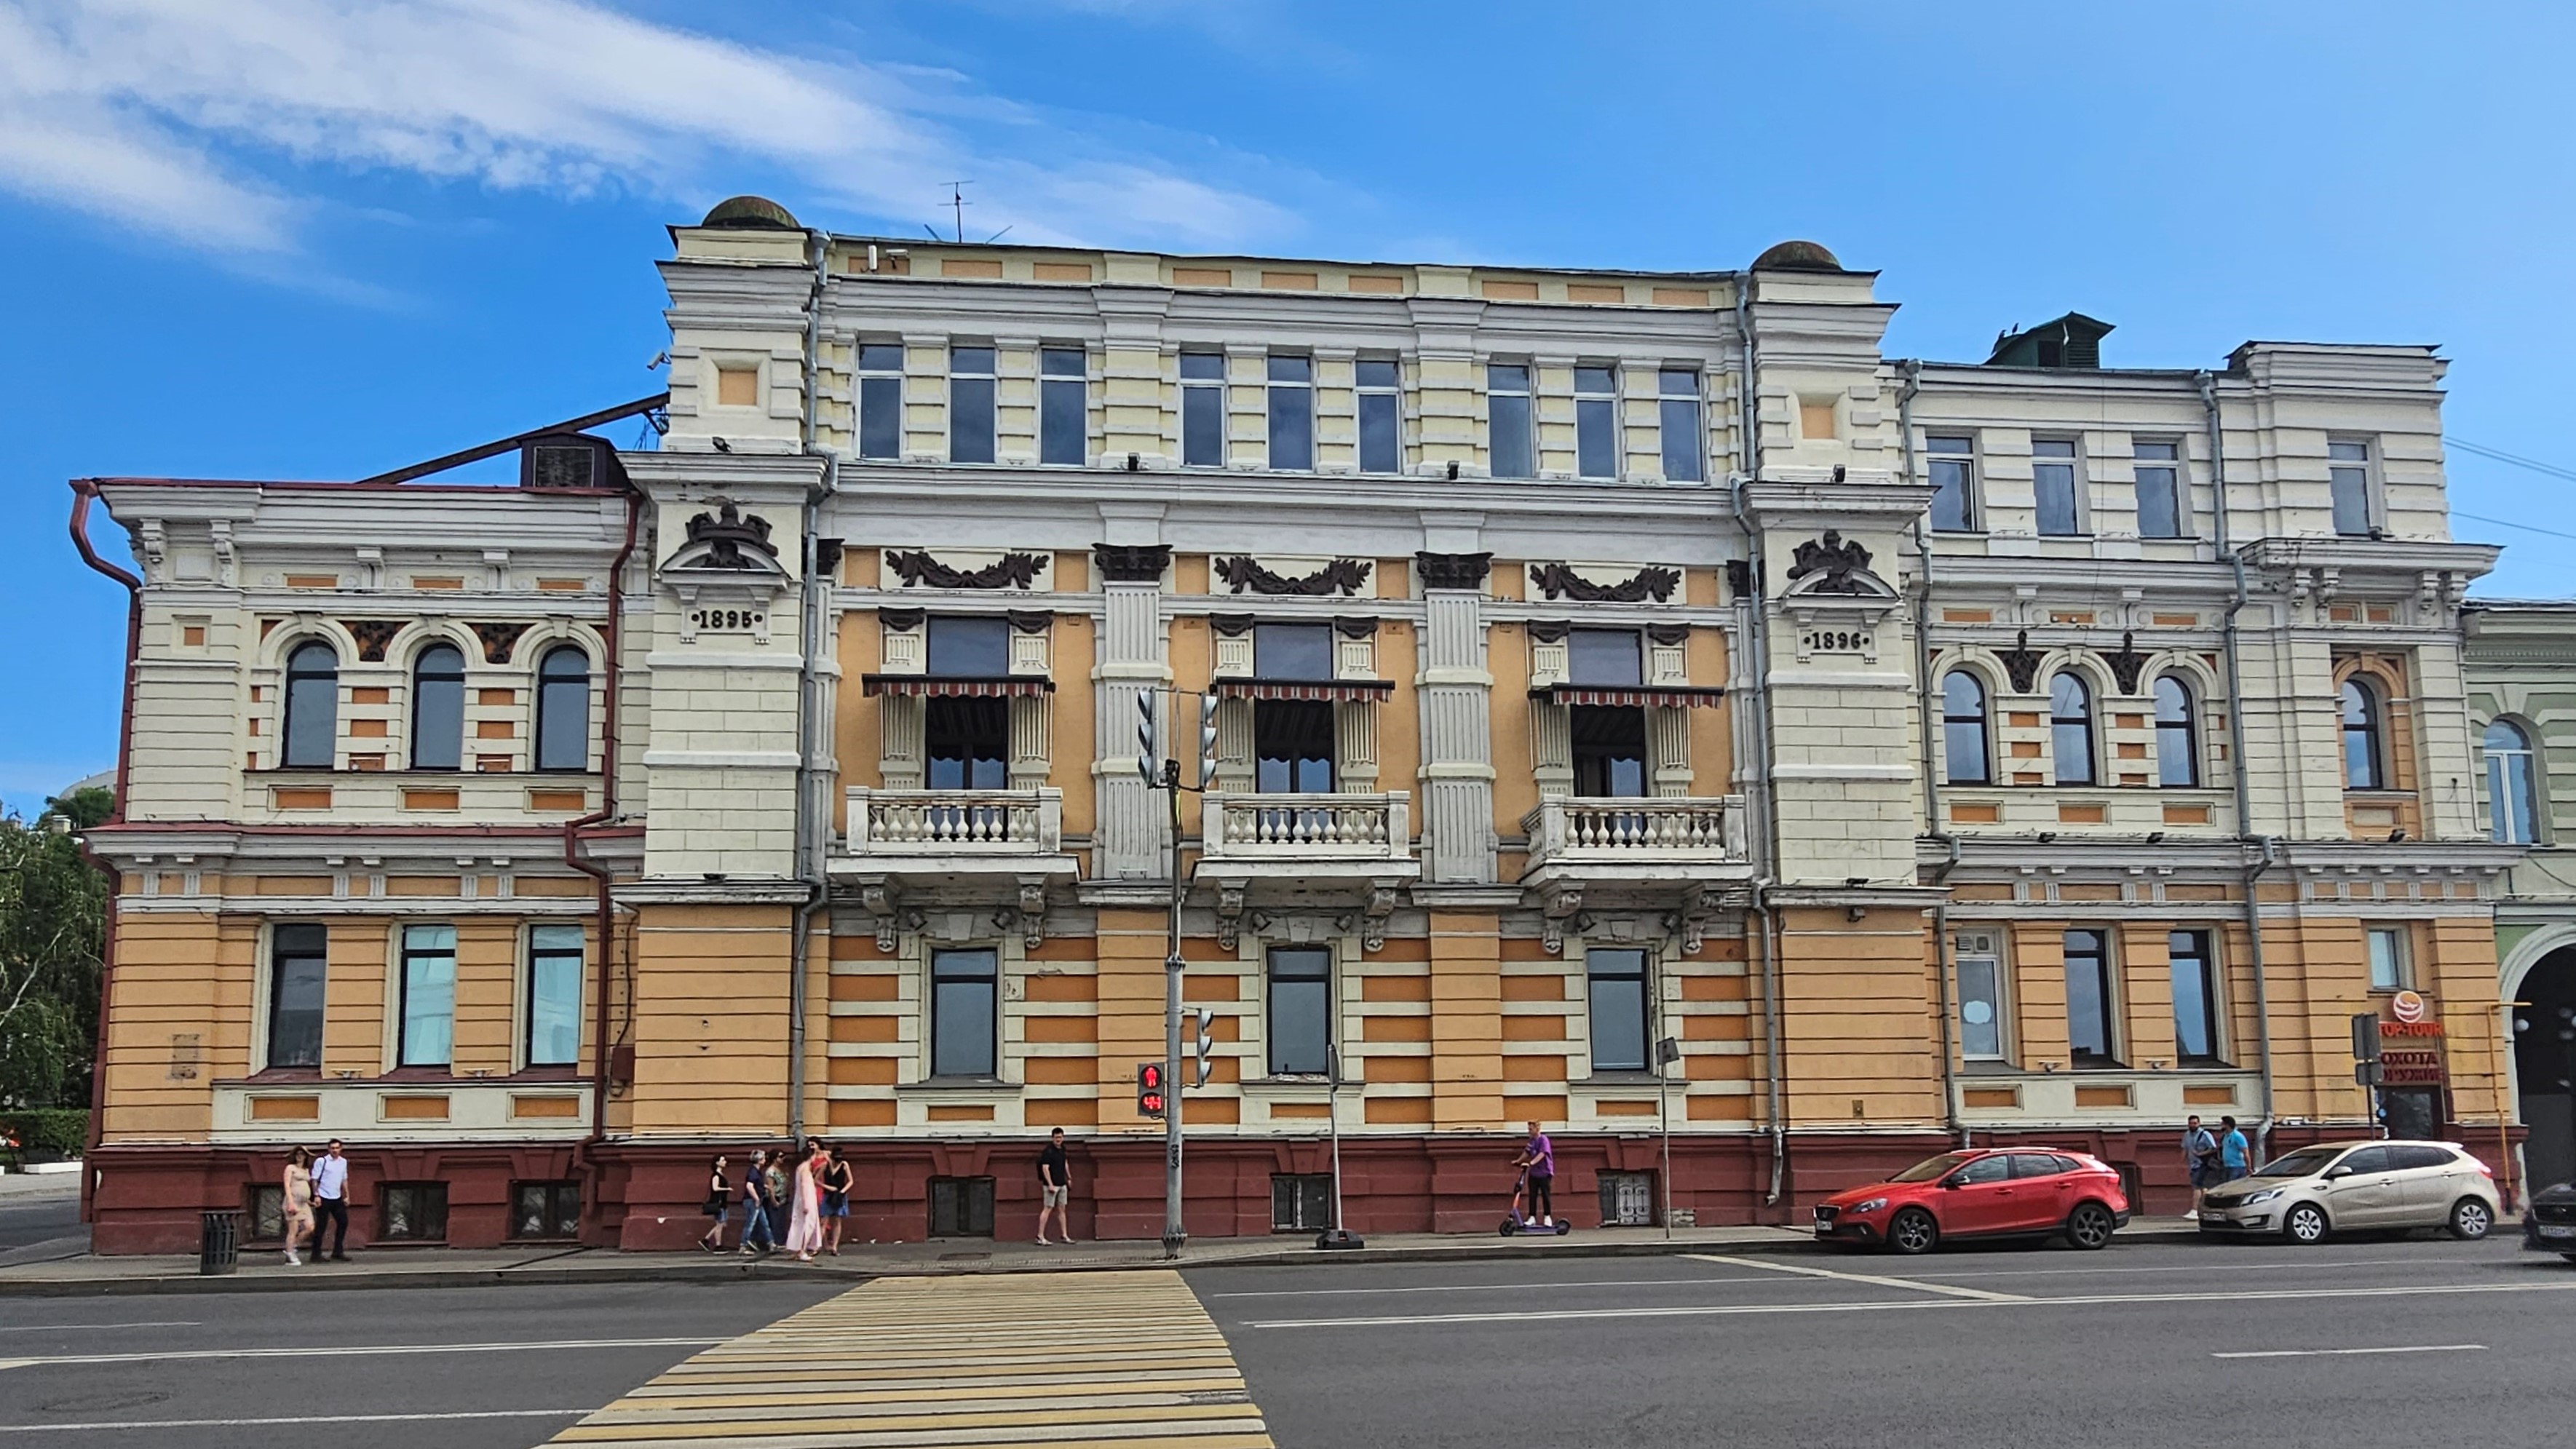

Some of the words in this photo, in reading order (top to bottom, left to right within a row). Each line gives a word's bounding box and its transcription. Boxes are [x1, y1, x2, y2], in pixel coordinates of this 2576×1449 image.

[700, 610, 752, 629] 1895
[1812, 632, 1861, 650] 1896
[2380, 1052, 2438, 1064] ОХОТА
